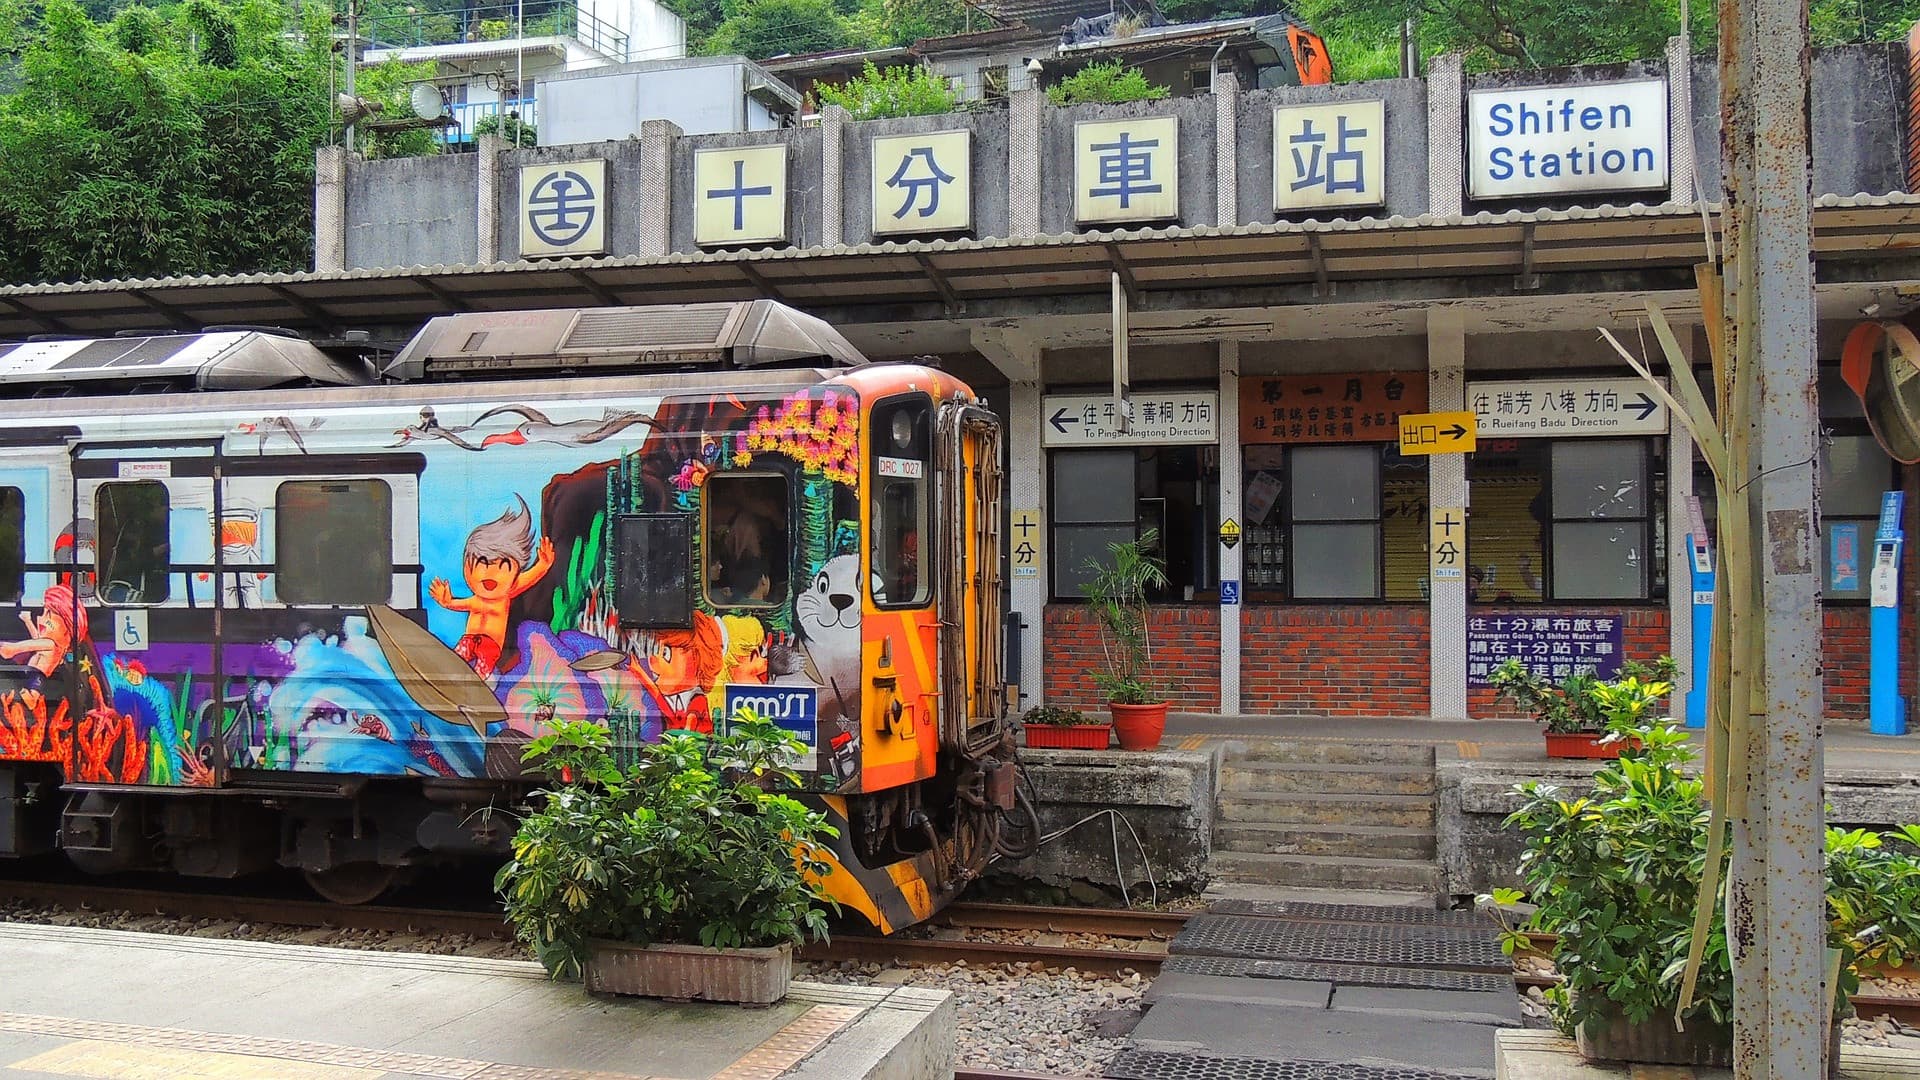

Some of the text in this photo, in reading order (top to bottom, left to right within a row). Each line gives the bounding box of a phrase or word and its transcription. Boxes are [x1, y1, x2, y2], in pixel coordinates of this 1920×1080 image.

[1488, 100, 1632, 138] Shifen
[1488, 140, 1655, 180] Station
[707, 116, 1368, 231] 十分車站
[1262, 378, 1405, 404] 第一月台
[1474, 389, 1618, 415] 往 瑞芳 八堵 方向
[1083, 403, 1097, 426] 往
[1142, 401, 1174, 425] 菁桐
[1180, 400, 1211, 424] 方向
[1475, 416, 1618, 429] To Rueifang Badu Direction
[1084, 428, 1095, 438] To
[1127, 428, 1166, 439] Jingtong
[1169, 426, 1211, 437] Direction
[1403, 424, 1437, 446] 出口
[880, 460, 919, 475] DRC 1027
[1014, 515, 1036, 563] 十分
[1435, 513, 1460, 564] 十分
[1469, 618, 1614, 632] 往十分瀑布旅客
[1469, 632, 1510, 641] Passengers
[1513, 633, 1533, 641] Going
[1547, 632, 1570, 640] Shifen
[1469, 641, 1613, 655] 請在十分站下車
[1495, 655, 1508, 663] Get
